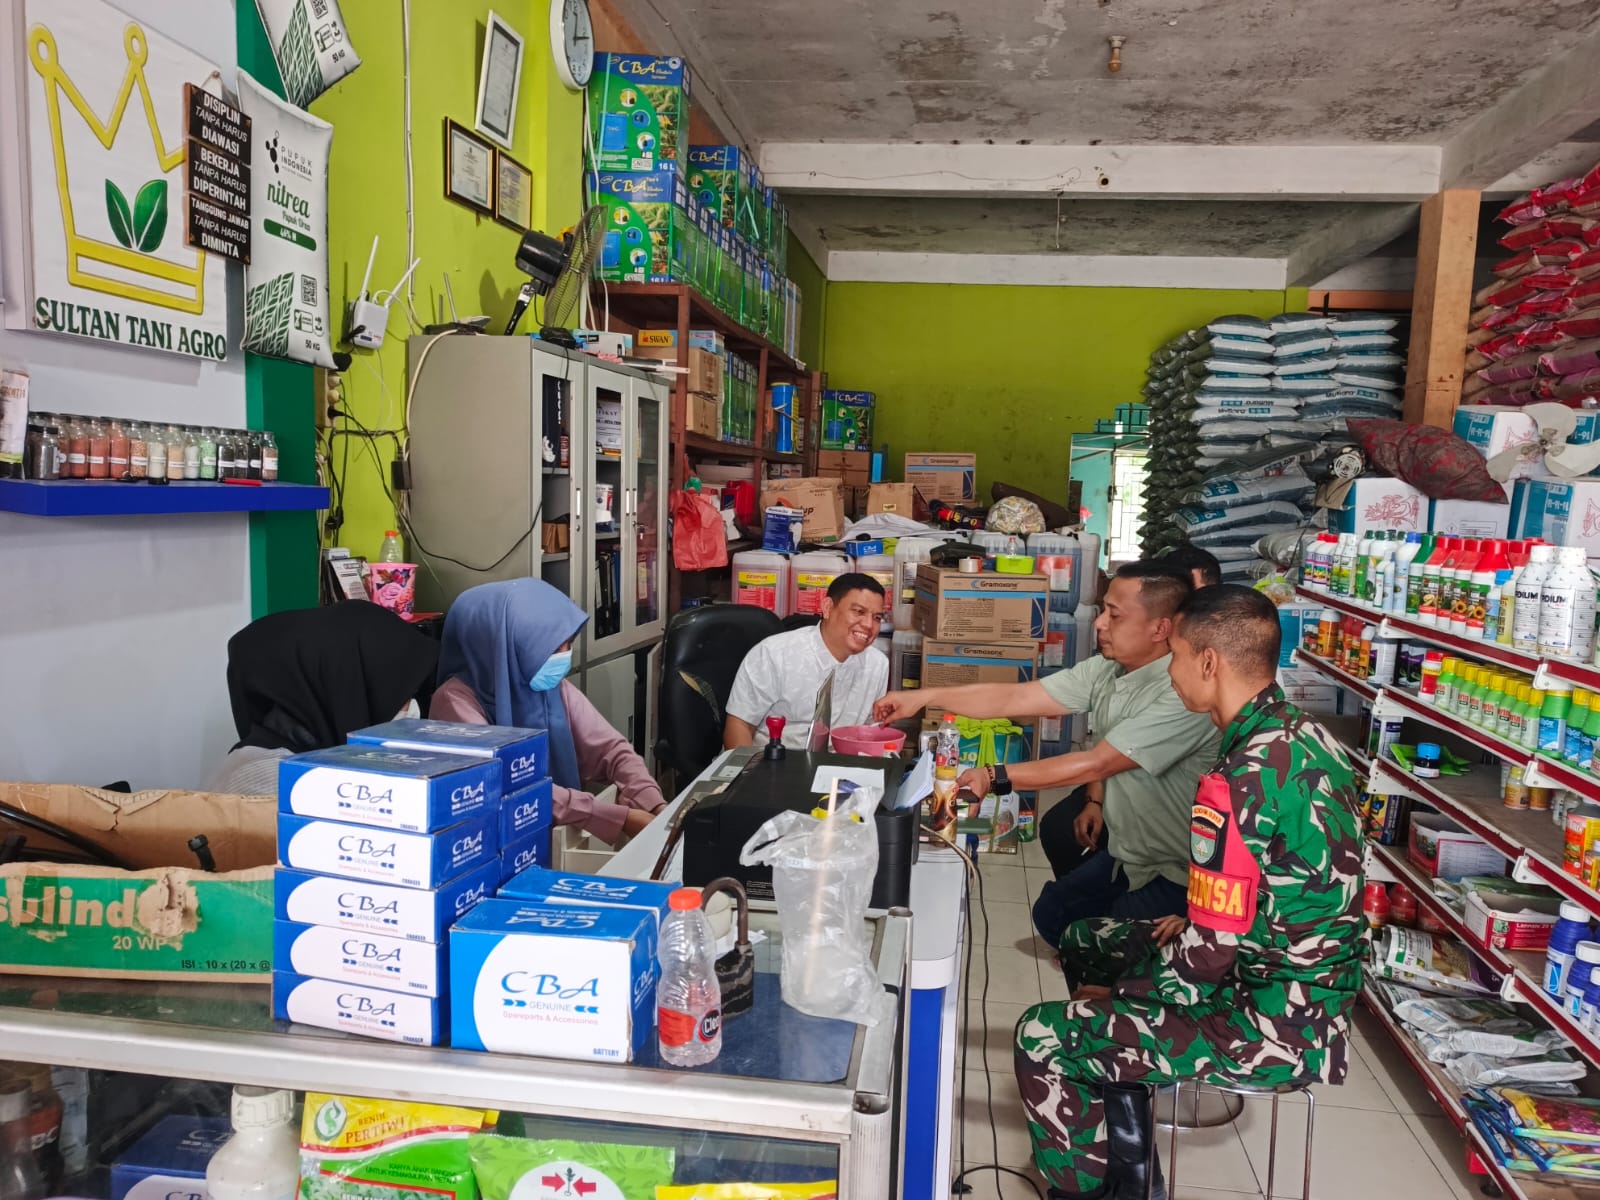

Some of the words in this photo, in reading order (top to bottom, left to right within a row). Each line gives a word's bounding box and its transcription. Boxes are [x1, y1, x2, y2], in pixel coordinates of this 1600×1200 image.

[619, 60, 655, 75] CBA
[203, 93, 241, 125] DISIPLIN
[195, 106, 220, 125] TANPA
[222, 118, 247, 142] HARUS
[202, 126, 239, 156] DIAWASI
[201, 148, 240, 177] BEKERJA
[281, 146, 313, 167] PUPUK
[281, 156, 313, 176] INDONESIA
[689, 151, 718, 162] CBA
[194, 161, 219, 181] TANPA
[221, 174, 247, 193] HARUS
[612, 179, 646, 193] CBA
[193, 177, 246, 211] DIPERINTAH
[267, 180, 310, 218] nitrea
[192, 198, 227, 220] TANGGUNG
[228, 212, 249, 229] JAWAB
[194, 215, 219, 231] TANPA
[221, 223, 247, 243] HARUS
[202, 233, 239, 258] DIMINTA
[36, 297, 120, 341] SULTAN
[126, 315, 172, 350] TANI
[177, 326, 226, 360] AGRO
[980, 581, 1018, 589] Gramoxone
[963, 648, 1004, 656] Gramoxone
[510, 753, 535, 772] CBA
[337, 782, 393, 804] CBA
[451, 781, 484, 802] CBA
[514, 799, 539, 819] CBA
[338, 836, 396, 857] CBA
[452, 831, 483, 855] CBA
[514, 844, 537, 867] CBA
[455, 882, 485, 909] CBA
[558, 878, 637, 893] CBA
[337, 892, 398, 914] CBA
[355, 913, 381, 924] GENUINE
[505, 916, 595, 929] CBA
[112, 935, 132, 950] 20
[137, 937, 167, 951] WP
[342, 939, 401, 962] CBA
[181, 960, 195, 969] ISI
[205, 960, 218, 969] 10
[230, 960, 247, 971] (20
[258, 960, 271, 971] @
[358, 960, 385, 971] GENUINE
[501, 971, 599, 999] CBA
[337, 993, 396, 1015] CBA
[529, 1001, 572, 1012] GENUINE
[353, 1014, 379, 1025] GENUINE
[503, 1010, 544, 1022] Spareparts
[553, 1015, 599, 1026] Accessories
[593, 1047, 619, 1057] BATTERY
[358, 1112, 386, 1126] BENIH
[345, 1116, 405, 1144] PERTIWI
